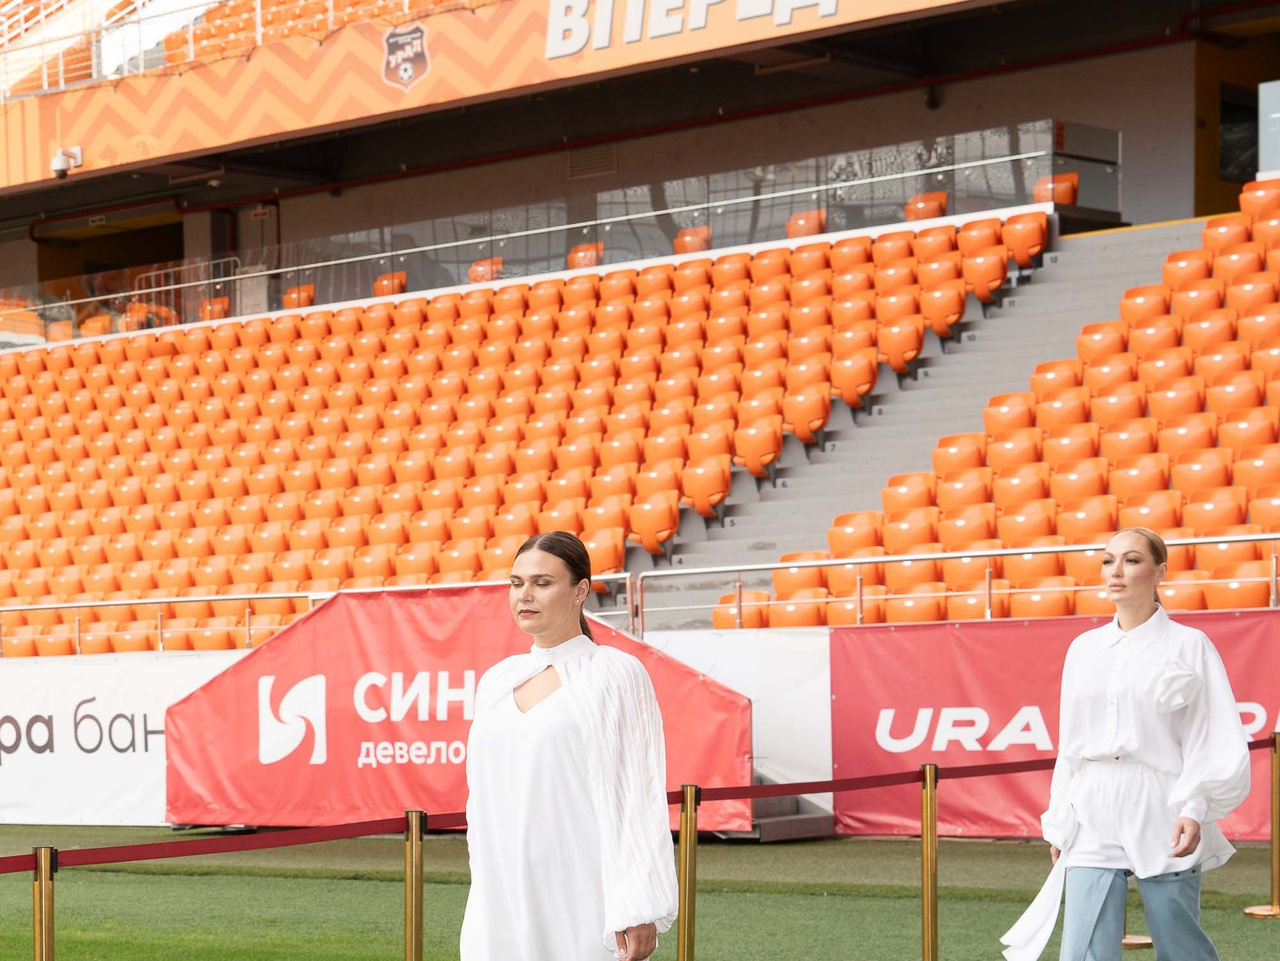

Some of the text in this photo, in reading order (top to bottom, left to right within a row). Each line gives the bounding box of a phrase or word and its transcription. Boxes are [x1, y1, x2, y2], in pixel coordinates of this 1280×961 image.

[546, 0, 839, 59] ВПЕР
[353, 668, 476, 723] СИН
[73, 696, 165, 754] бан
[874, 705, 1054, 754] URA
[357, 740, 466, 769] девело
